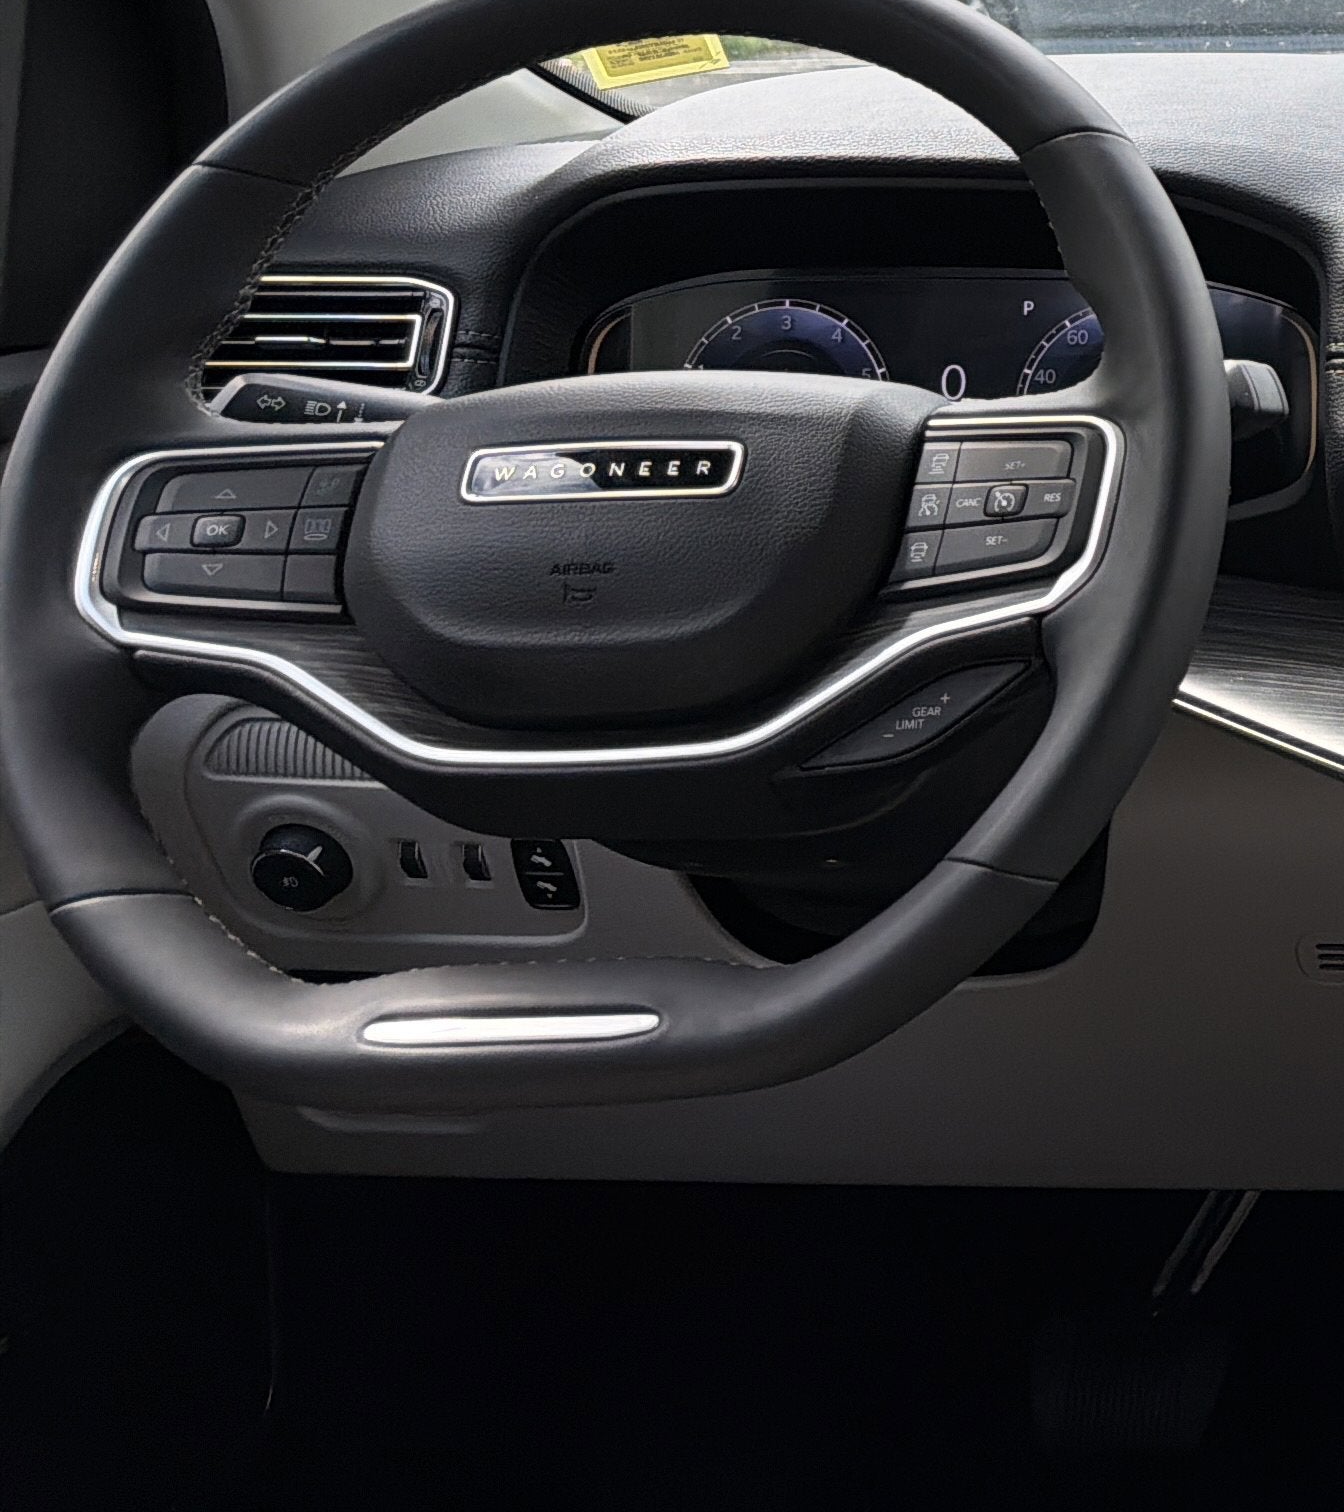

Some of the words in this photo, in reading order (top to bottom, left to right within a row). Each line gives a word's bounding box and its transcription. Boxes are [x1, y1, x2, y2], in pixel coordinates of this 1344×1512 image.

[1022, 300, 1036, 317] P
[781, 315, 793, 330] 3
[731, 326, 743, 341] 2
[831, 328, 844, 343] 4
[1066, 329, 1089, 345] 60
[941, 364, 967, 402] 0
[1034, 368, 1056, 385] 40
[493, 459, 712, 482] WAGONEER
[955, 498, 982, 508] CANC
[1043, 492, 1062, 503] RES
[205, 523, 230, 537] OK
[911, 706, 942, 716] GEAR
[895, 719, 925, 731] LIMIT
